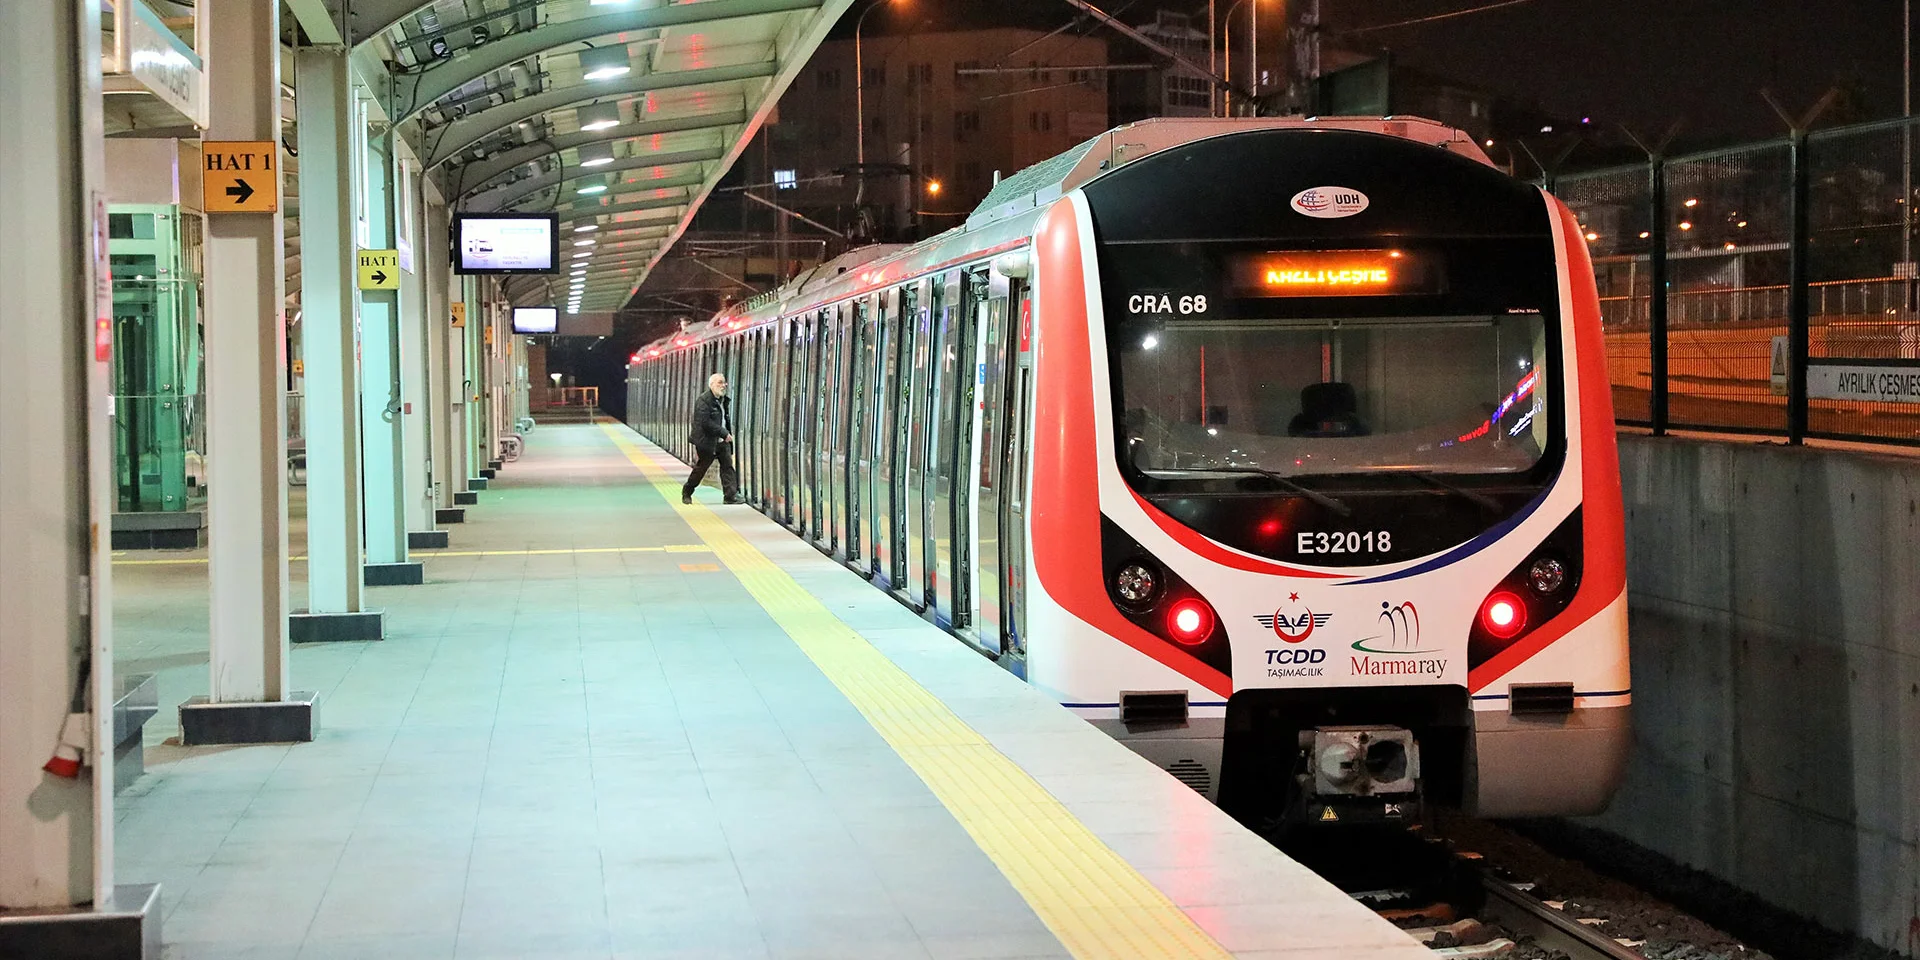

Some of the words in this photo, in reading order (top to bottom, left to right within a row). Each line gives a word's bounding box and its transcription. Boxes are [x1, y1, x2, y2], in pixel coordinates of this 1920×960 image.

[206, 153, 255, 170] HAT
[263, 153, 271, 170] 1
[1335, 194, 1360, 204] UDH
[361, 256, 387, 266] HAT
[392, 256, 396, 266] 1
[1128, 295, 1173, 314] CRA
[1179, 294, 1207, 314] 68
[1838, 372, 1877, 394] AYRILIK
[1297, 530, 1392, 554] E32018
[1265, 649, 1327, 664] TCDD
[1267, 668, 1324, 679] TAŞIMACILIK
[1351, 656, 1448, 679] Marmaray
